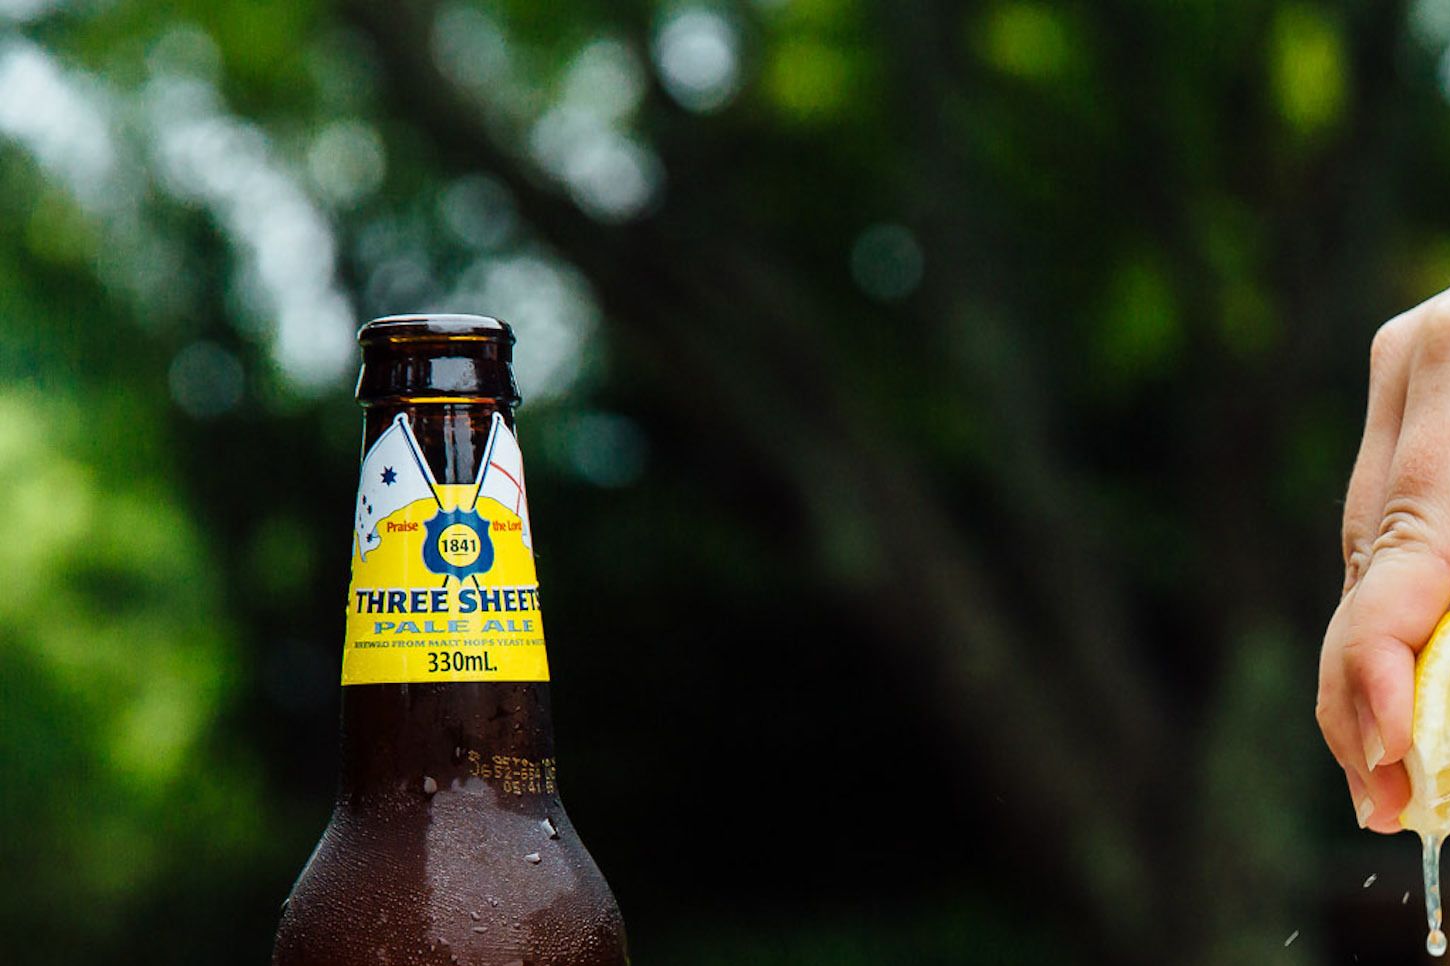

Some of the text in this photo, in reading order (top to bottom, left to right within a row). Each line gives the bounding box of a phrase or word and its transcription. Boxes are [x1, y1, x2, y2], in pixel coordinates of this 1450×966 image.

[386, 520, 419, 532] Praise
[492, 520, 506, 531] the
[441, 539, 477, 552] 1841
[355, 588, 449, 613] THREE
[374, 619, 534, 634] PALE ALE
[392, 640, 425, 648] FROM
[428, 651, 498, 673] 330mL.
